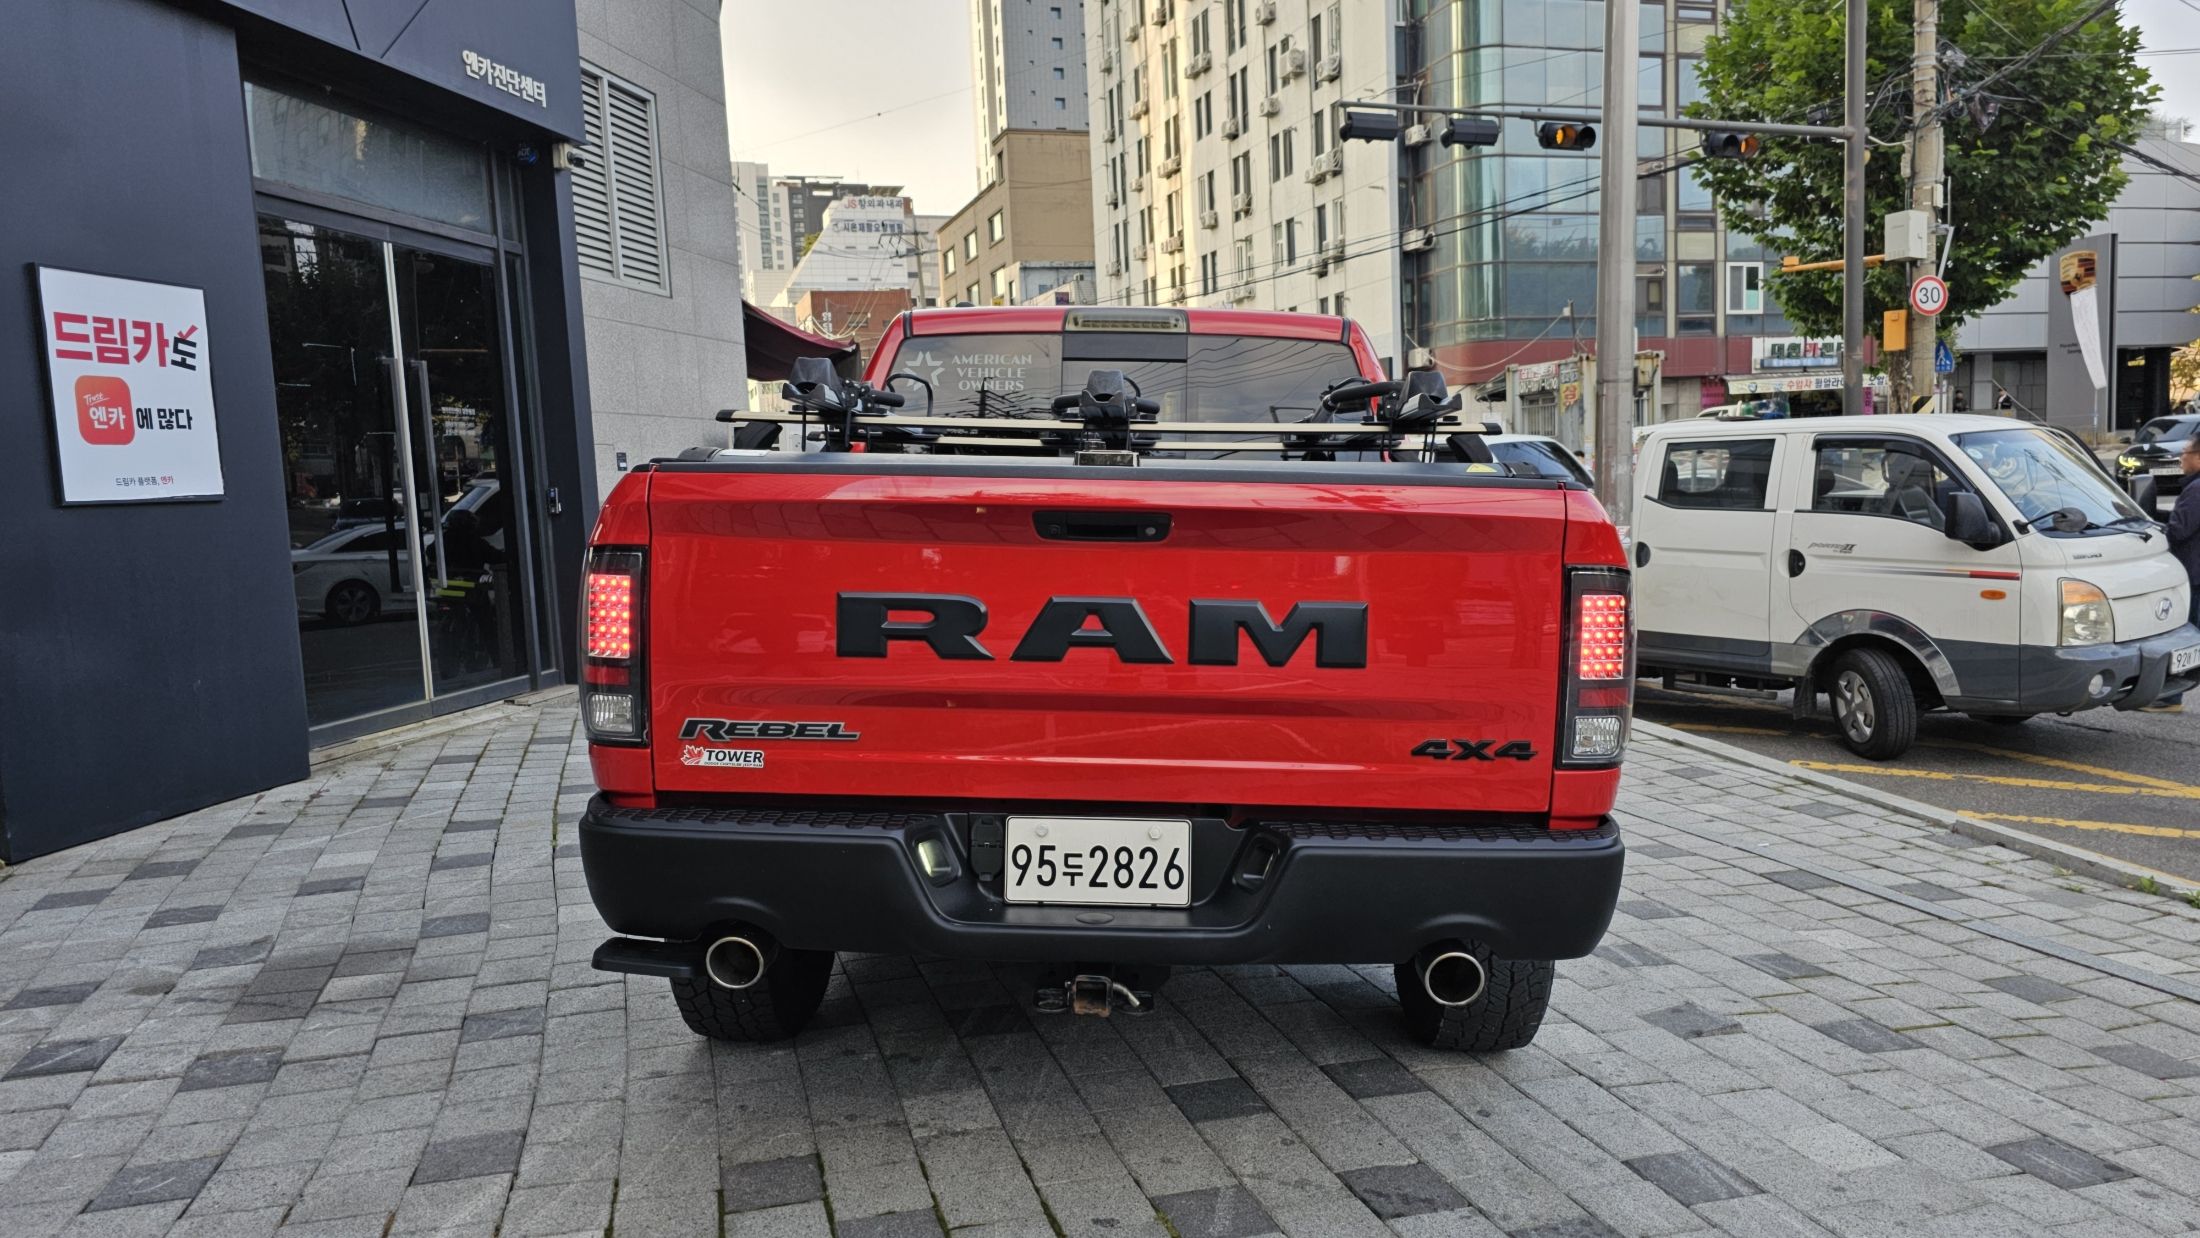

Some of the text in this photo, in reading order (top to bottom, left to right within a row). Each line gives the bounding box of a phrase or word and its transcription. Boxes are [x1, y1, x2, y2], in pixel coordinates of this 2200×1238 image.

[462, 49, 547, 108] 엔카진단센터
[1919, 286, 1941, 304] 30
[53, 311, 198, 371] 드림카도
[951, 354, 1033, 365] AMERICAN
[956, 367, 1026, 378] VEHICLE
[958, 380, 1025, 391] OWNERS
[89, 406, 193, 430] 엔카 에 많다
[115, 477, 136, 487] 드림카
[836, 591, 1368, 668] RAM
[679, 717, 862, 742] REBEL
[706, 749, 763, 763] TOWER
[1410, 738, 1538, 761] 4X4
[1011, 843, 1185, 890] 95두2826
